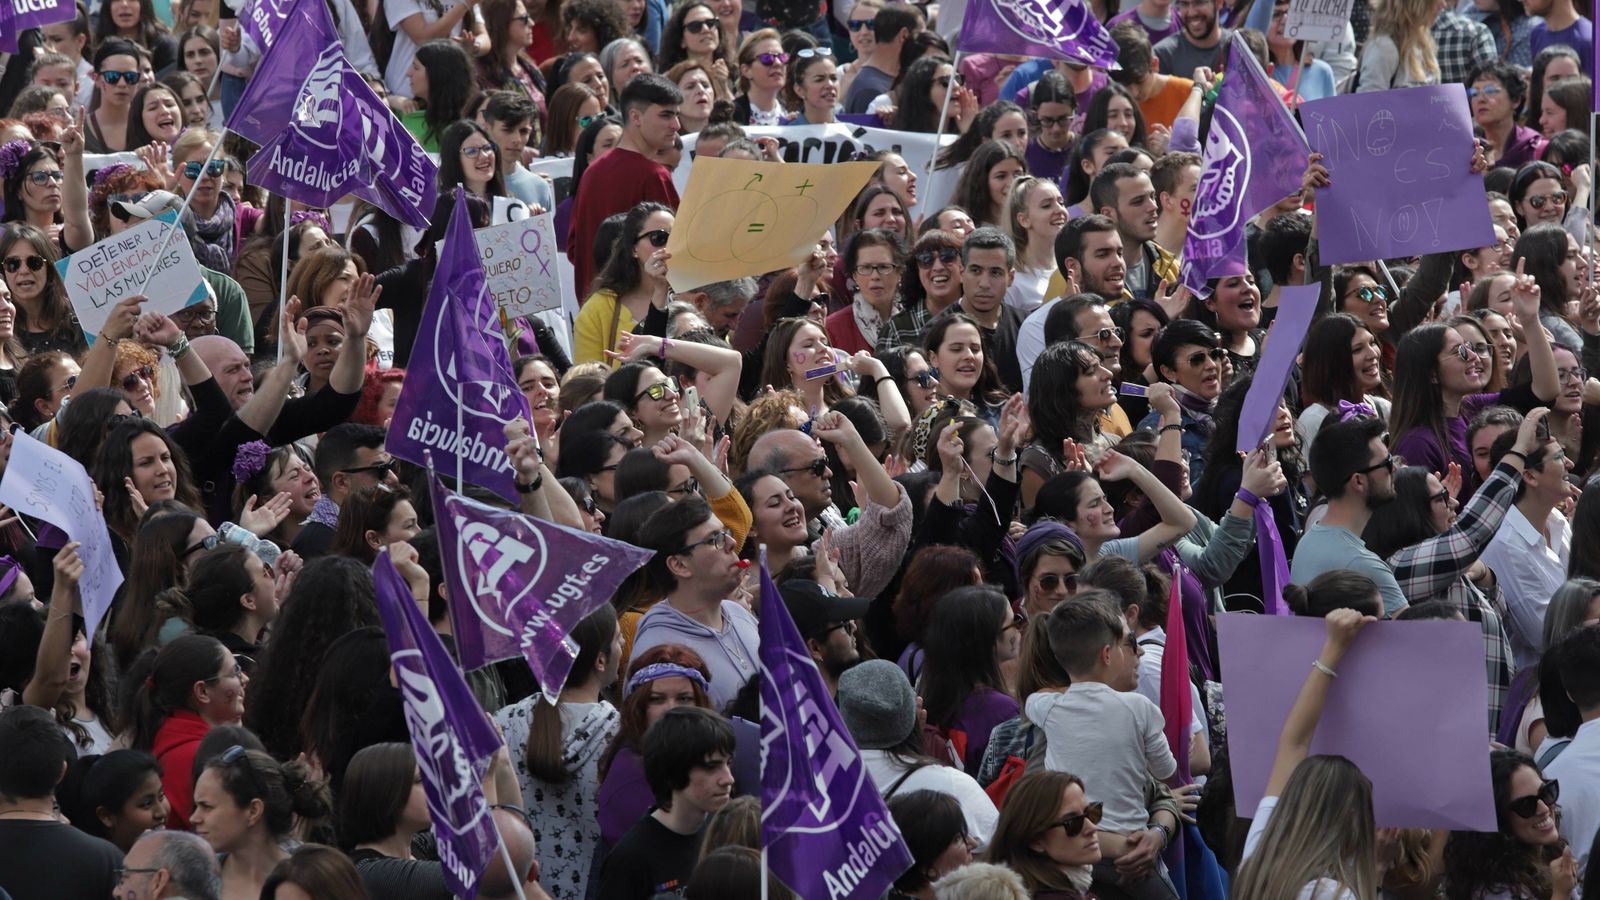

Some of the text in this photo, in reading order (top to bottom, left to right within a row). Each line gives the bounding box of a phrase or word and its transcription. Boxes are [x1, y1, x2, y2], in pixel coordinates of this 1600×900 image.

[1394, 147, 1450, 184] ES
[78, 222, 171, 274] DETENER LA
